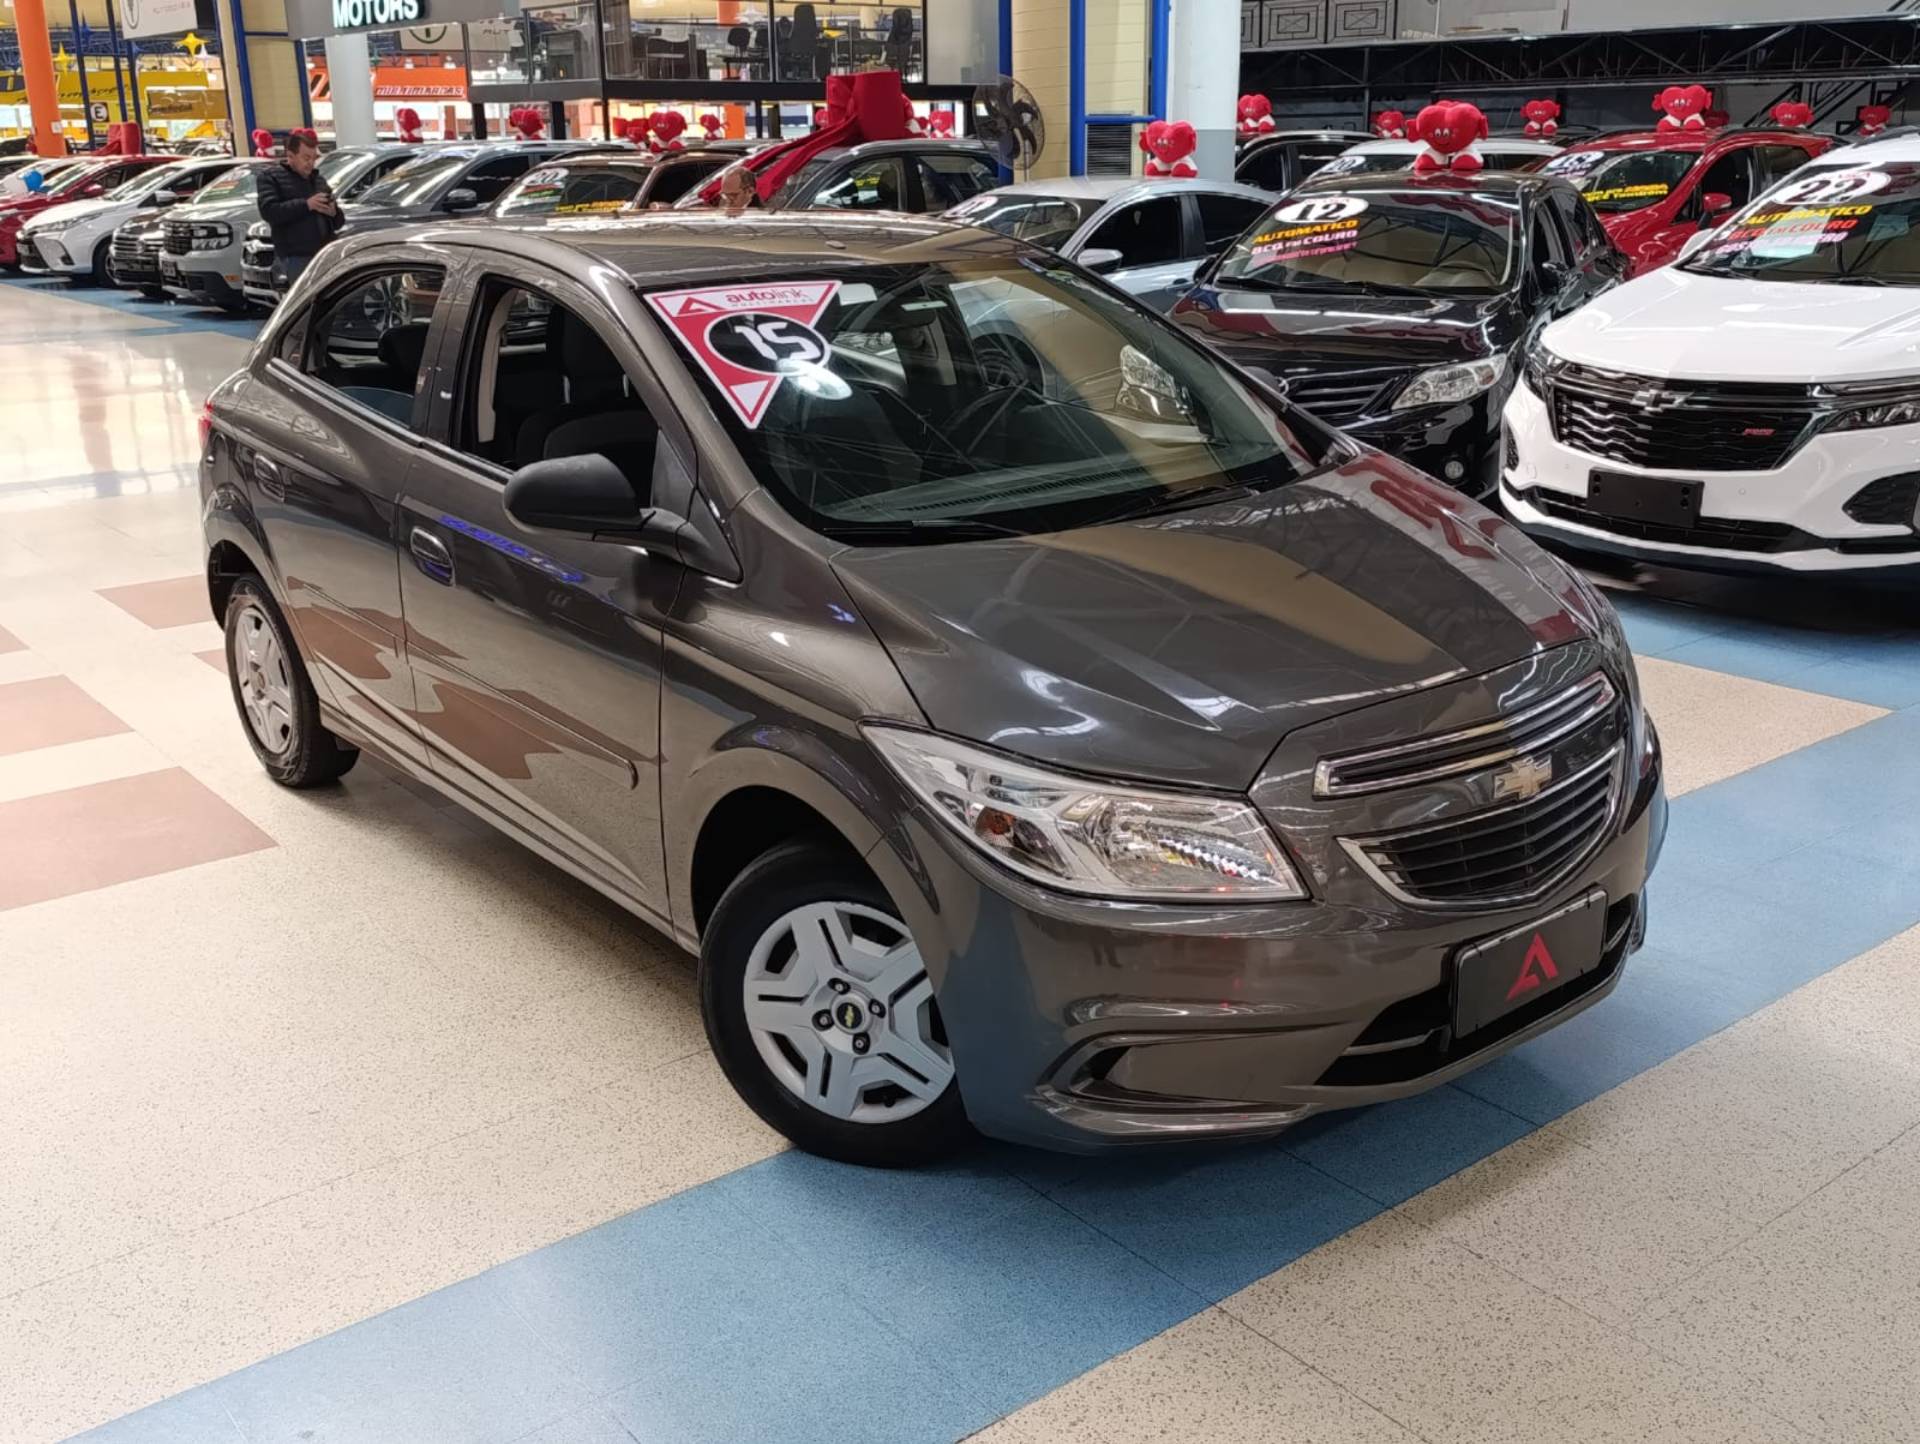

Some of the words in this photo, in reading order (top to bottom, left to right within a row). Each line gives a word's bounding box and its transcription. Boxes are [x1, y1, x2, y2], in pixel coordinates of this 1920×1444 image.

[333, 0, 419, 28] MOTORS
[1783, 179, 1867, 202] 22
[1291, 203, 1347, 221] 12
[1303, 230, 1359, 246] COURO
[726, 288, 806, 303] autolink
[734, 322, 821, 361] 15
